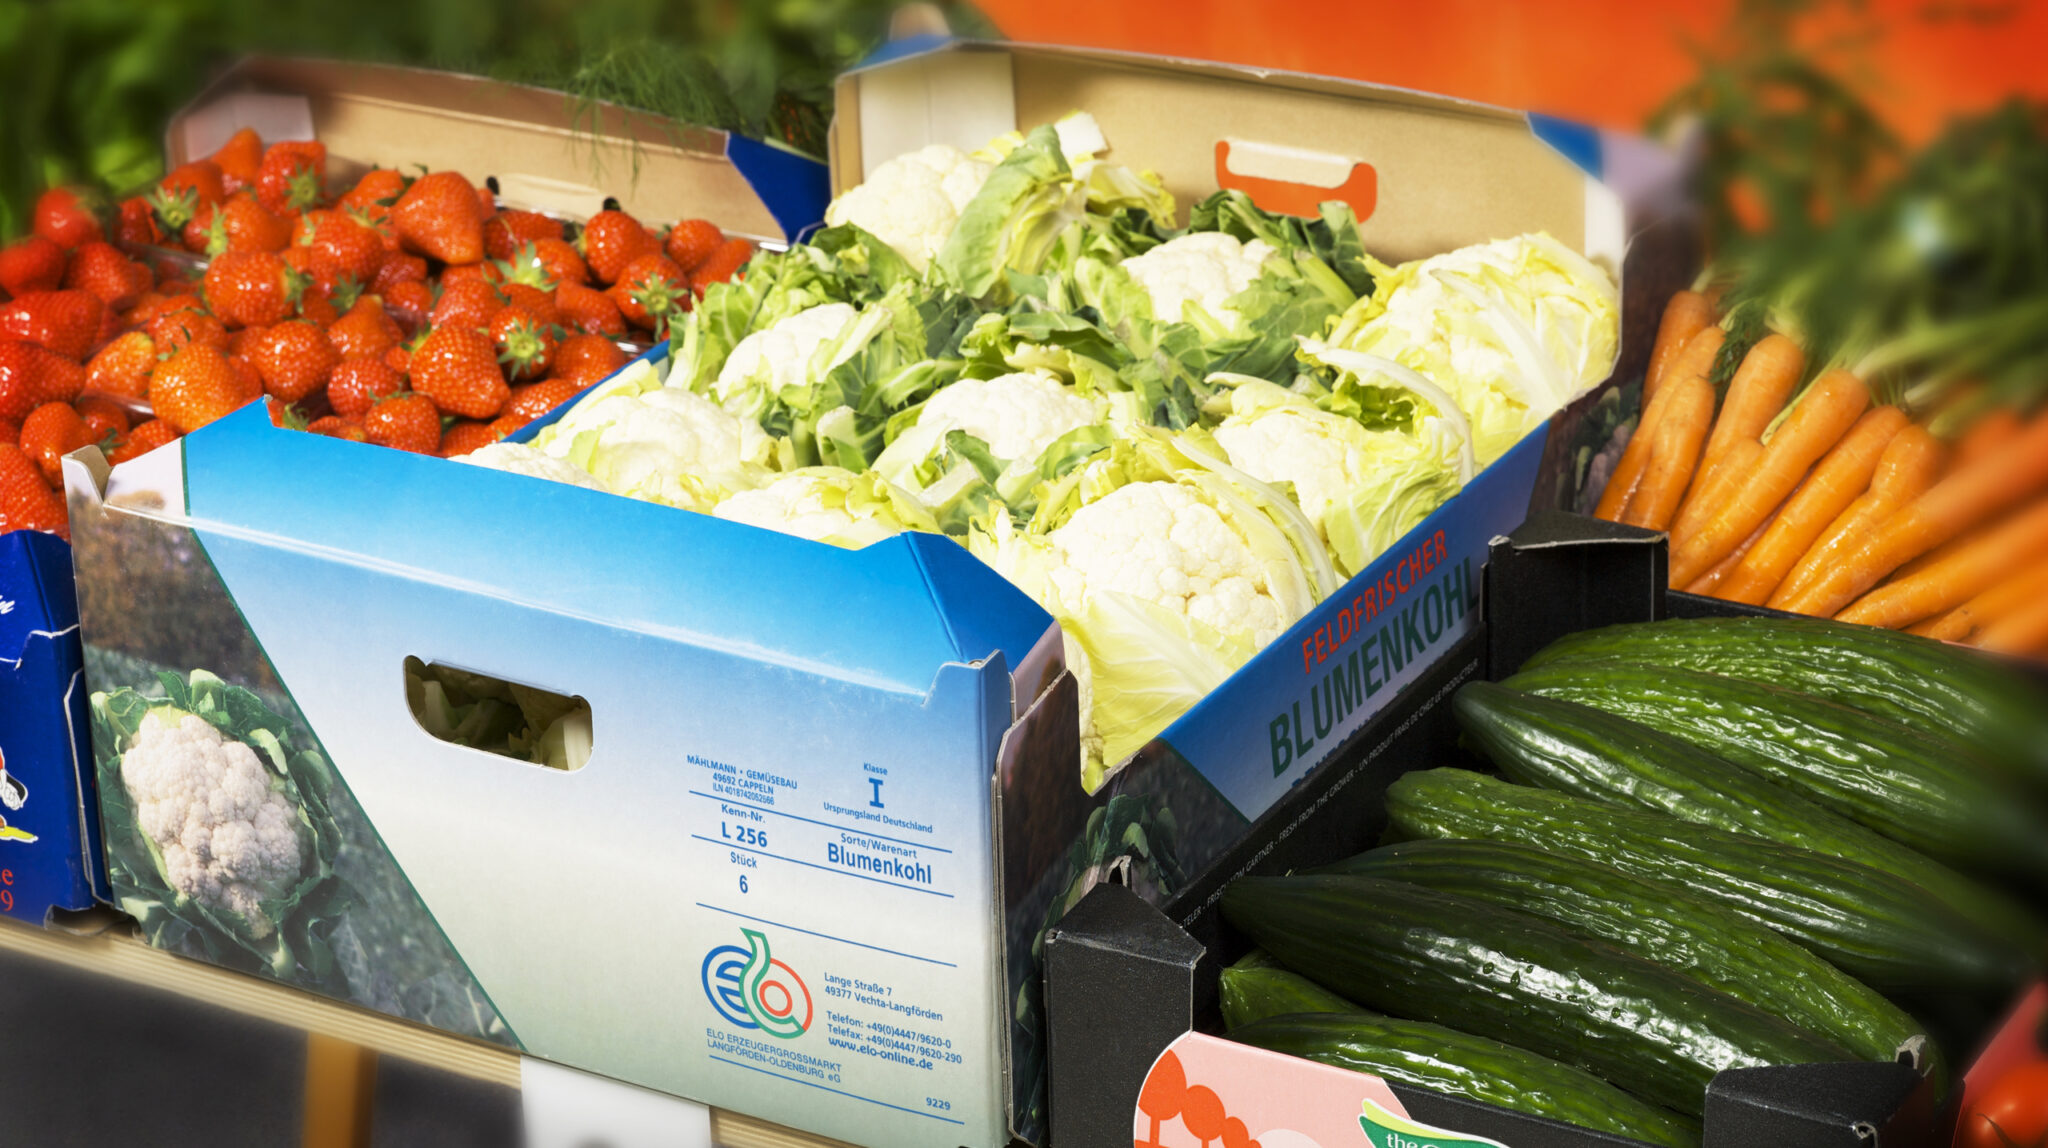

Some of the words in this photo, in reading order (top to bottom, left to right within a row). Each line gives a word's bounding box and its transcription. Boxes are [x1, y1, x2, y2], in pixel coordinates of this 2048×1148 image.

[1302, 529, 1448, 674] FELDFRISCHER
[1269, 556, 1479, 778] BLUMENKOHL
[1279, 820, 1298, 842] FRESH
[1298, 804, 1315, 825] FROM
[1316, 791, 1330, 808] THE
[1329, 769, 1355, 797] GROWER
[1359, 756, 1369, 771] UN
[1368, 732, 1394, 762] PRODUIT
[1394, 719, 1411, 739] FRAIS
[1410, 711, 1419, 725] DE
[1419, 697, 1435, 718] CHEZ
[1434, 689, 1443, 704] LE
[1442, 657, 1479, 696] PRODUCTEUR
[687, 755, 736, 775] MÄHLMANN
[746, 769, 798, 789] GEMÜSEBAU
[713, 772, 736, 786] 49692
[738, 779, 774, 795] CAPPELN
[863, 762, 888, 776] Klasse
[713, 783, 723, 793] ILN
[868, 777, 884, 809] I
[721, 803, 766, 823] Kenn-Nr.
[823, 801, 881, 822] Ursprungsland
[882, 815, 933, 833] Deutschland
[721, 821, 731, 839] L
[736, 825, 768, 848] 256
[840, 832, 918, 859] Sorte/Warenart
[730, 851, 758, 869] Stück
[827, 842, 932, 884] Blumenkohl
[739, 874, 749, 894] 6
[824, 972, 852, 988] Lange
[854, 979, 885, 995] Straße
[886, 986, 893, 997] 7
[825, 985, 852, 999] 49377
[854, 992, 943, 1021] Vechta-Langförden
[826, 1010, 864, 1028] Telefon:
[866, 1022, 952, 1049] +49(0)4447/9620-0
[827, 1023, 864, 1041] Telefax:
[866, 1034, 962, 1064] +49(0)4447/9620-290
[706, 1028, 725, 1040] ELO
[727, 1033, 842, 1073] ERZEUGERGROSSMARKT
[707, 1039, 825, 1079] LANGFÖRDEN-OLDENBURG
[828, 1073, 841, 1083] eG
[828, 1037, 934, 1070] www.elo-online.de
[926, 1097, 951, 1111] 9229
[1386, 1133, 1418, 1148] the
